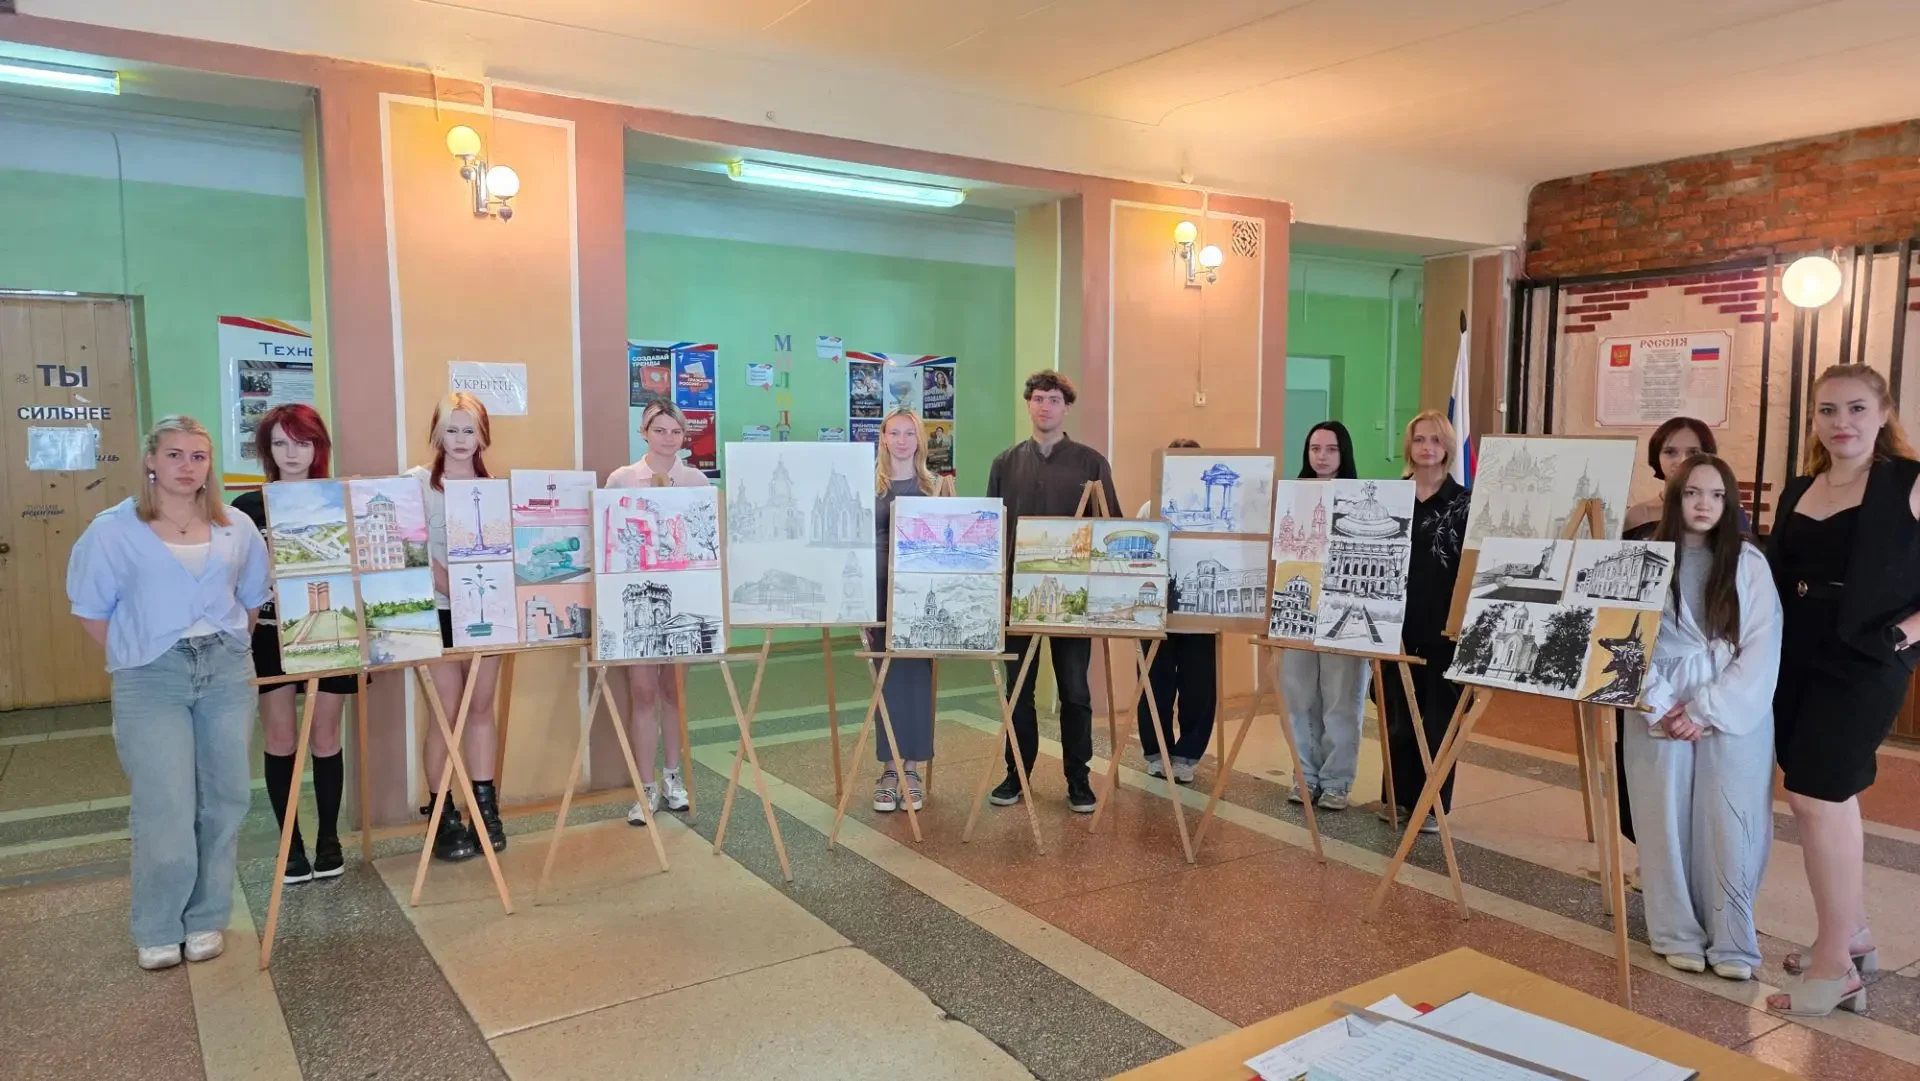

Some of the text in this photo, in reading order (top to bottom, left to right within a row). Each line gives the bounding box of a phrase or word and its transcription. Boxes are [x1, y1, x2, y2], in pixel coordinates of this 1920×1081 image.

[1640, 338, 1688, 348] РОССИЯ
[632, 354, 669, 362] СОЗДАВАЙ
[36, 364, 88, 388] ТЫ
[17, 407, 112, 420] СИЛЬНЕЕ
